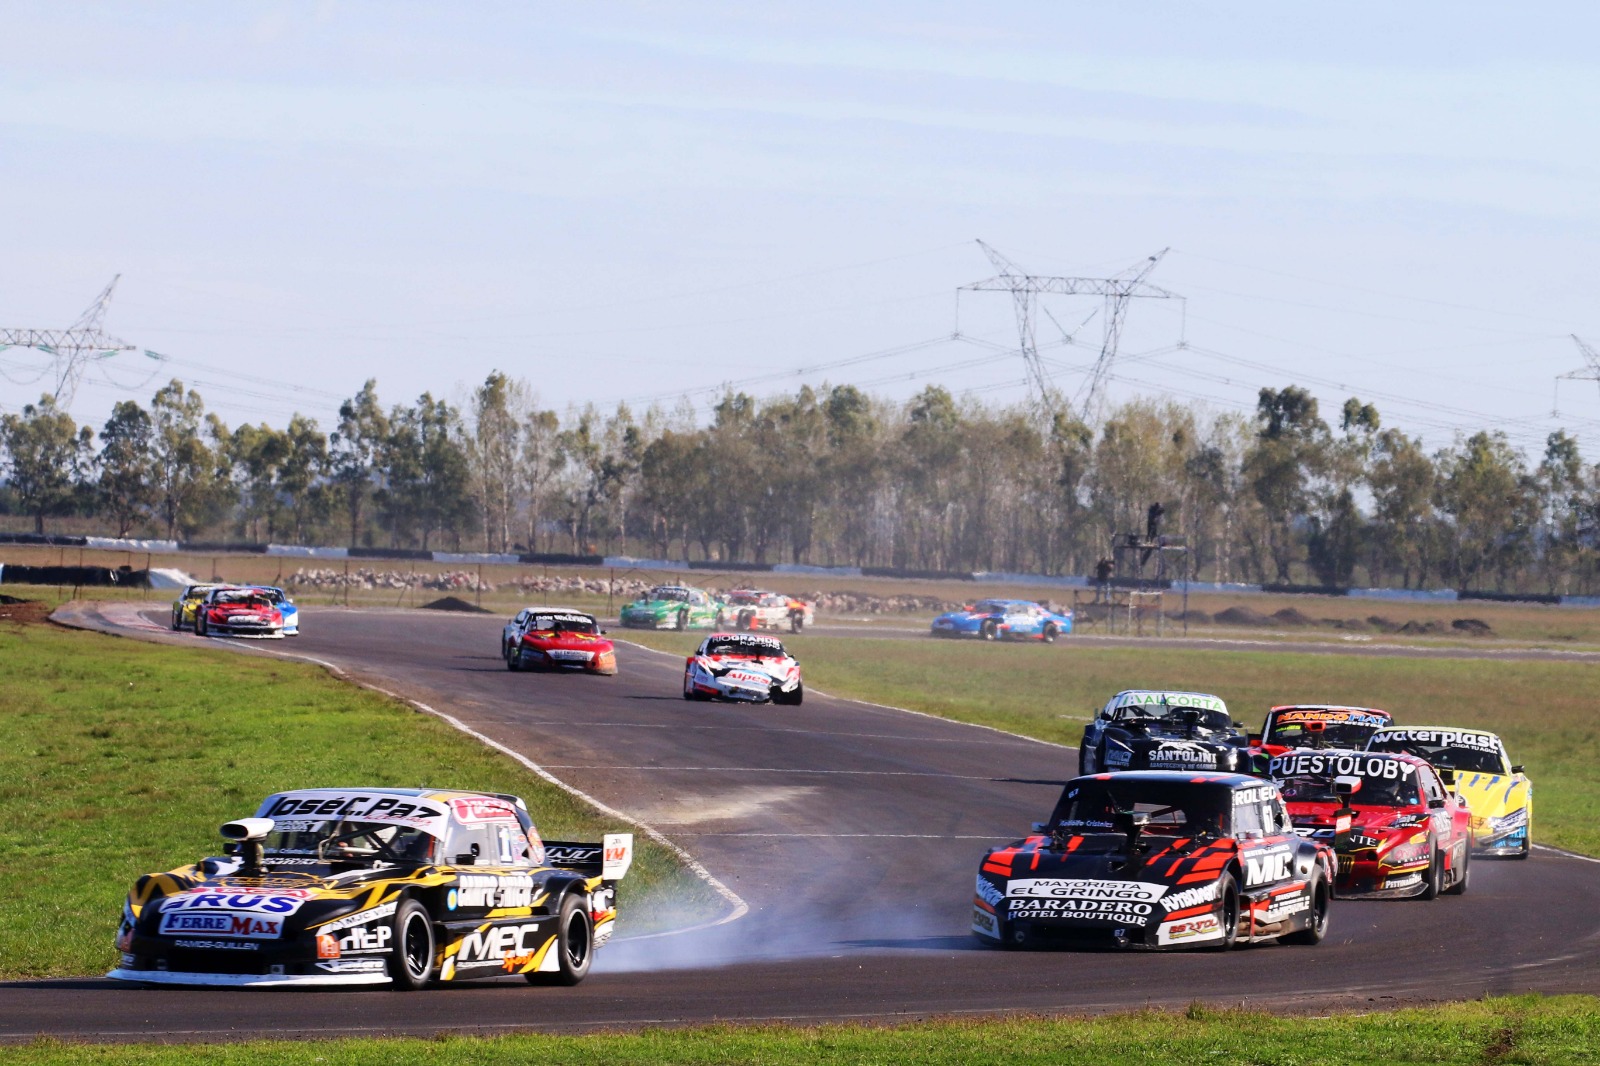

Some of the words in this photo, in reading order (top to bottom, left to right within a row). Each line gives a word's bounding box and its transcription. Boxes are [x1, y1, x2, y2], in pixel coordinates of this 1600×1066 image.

[1144, 695, 1221, 710] ALCORTA
[1374, 730, 1500, 751] waterplast
[1149, 750, 1217, 763] SANTOLINI
[498, 827, 513, 863] 1
[1034, 880, 1141, 890] MAYORISTA
[1011, 887, 1039, 896] EL
[1049, 888, 1153, 900] GRINGO
[190, 894, 294, 913] RUS
[1008, 899, 1153, 915] BARADERO
[1008, 910, 1058, 920] HOTEL
[1061, 911, 1149, 927] BOUTIQUE
[456, 924, 540, 961] MEC
